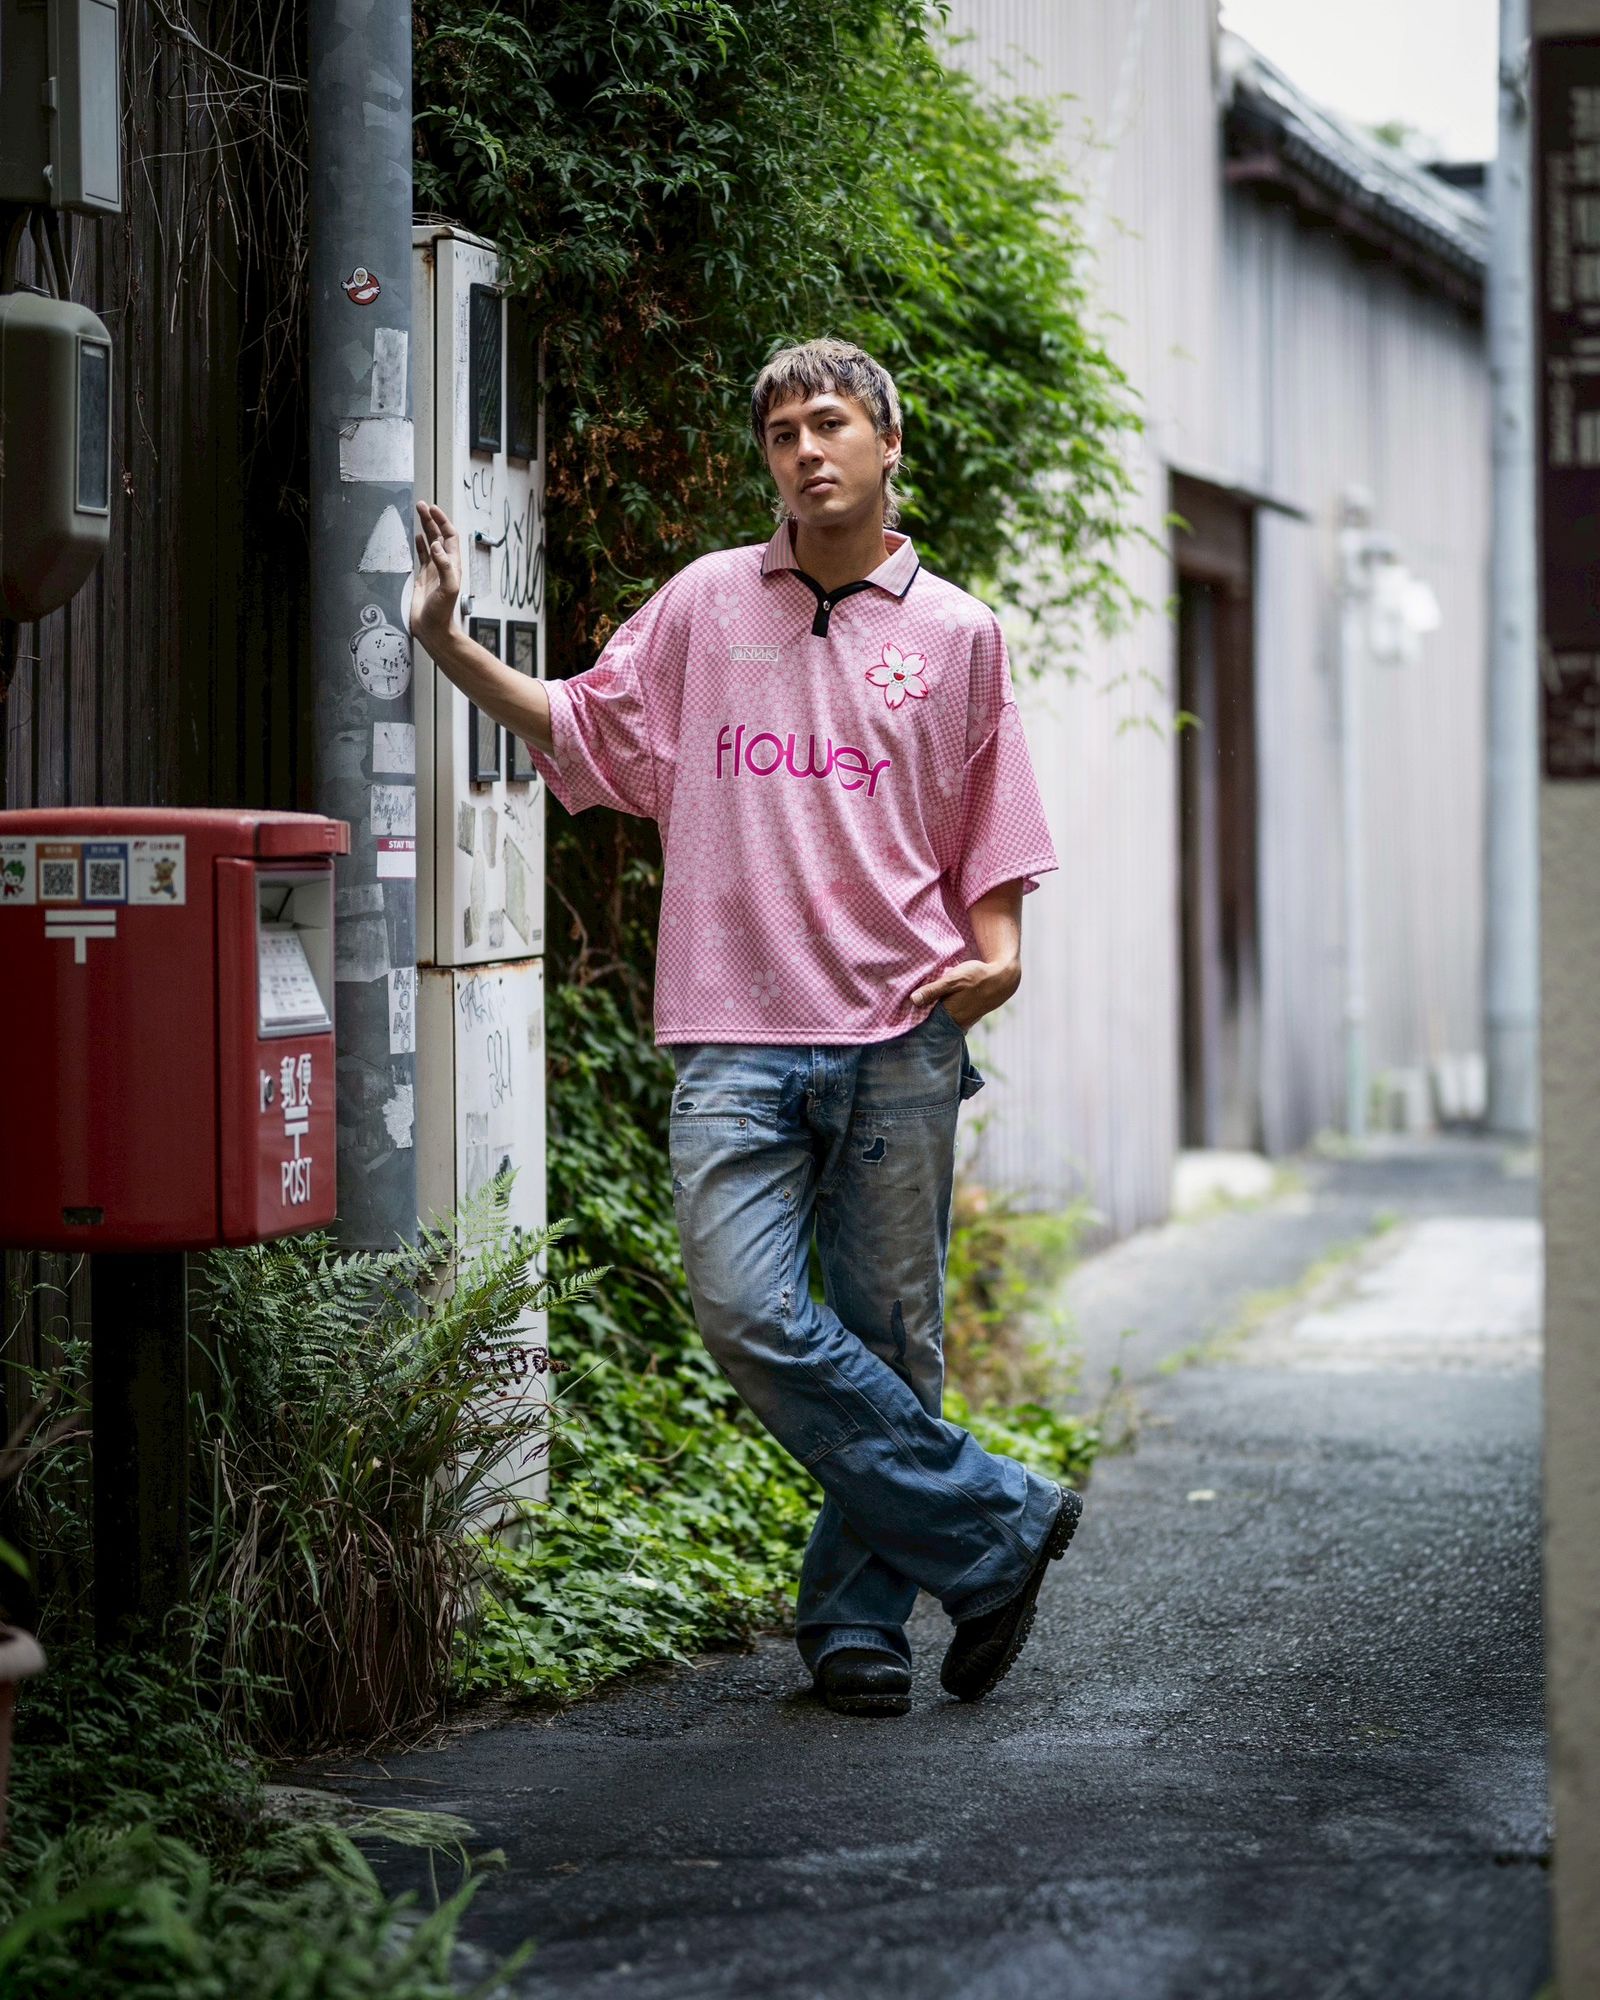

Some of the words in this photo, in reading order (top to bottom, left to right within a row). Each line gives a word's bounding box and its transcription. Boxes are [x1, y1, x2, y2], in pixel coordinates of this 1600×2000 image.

[716, 723, 892, 798] flower
[388, 840, 404, 849] STAY
[279, 1053, 313, 1108] 郵便
[280, 1156, 313, 1207] POST
